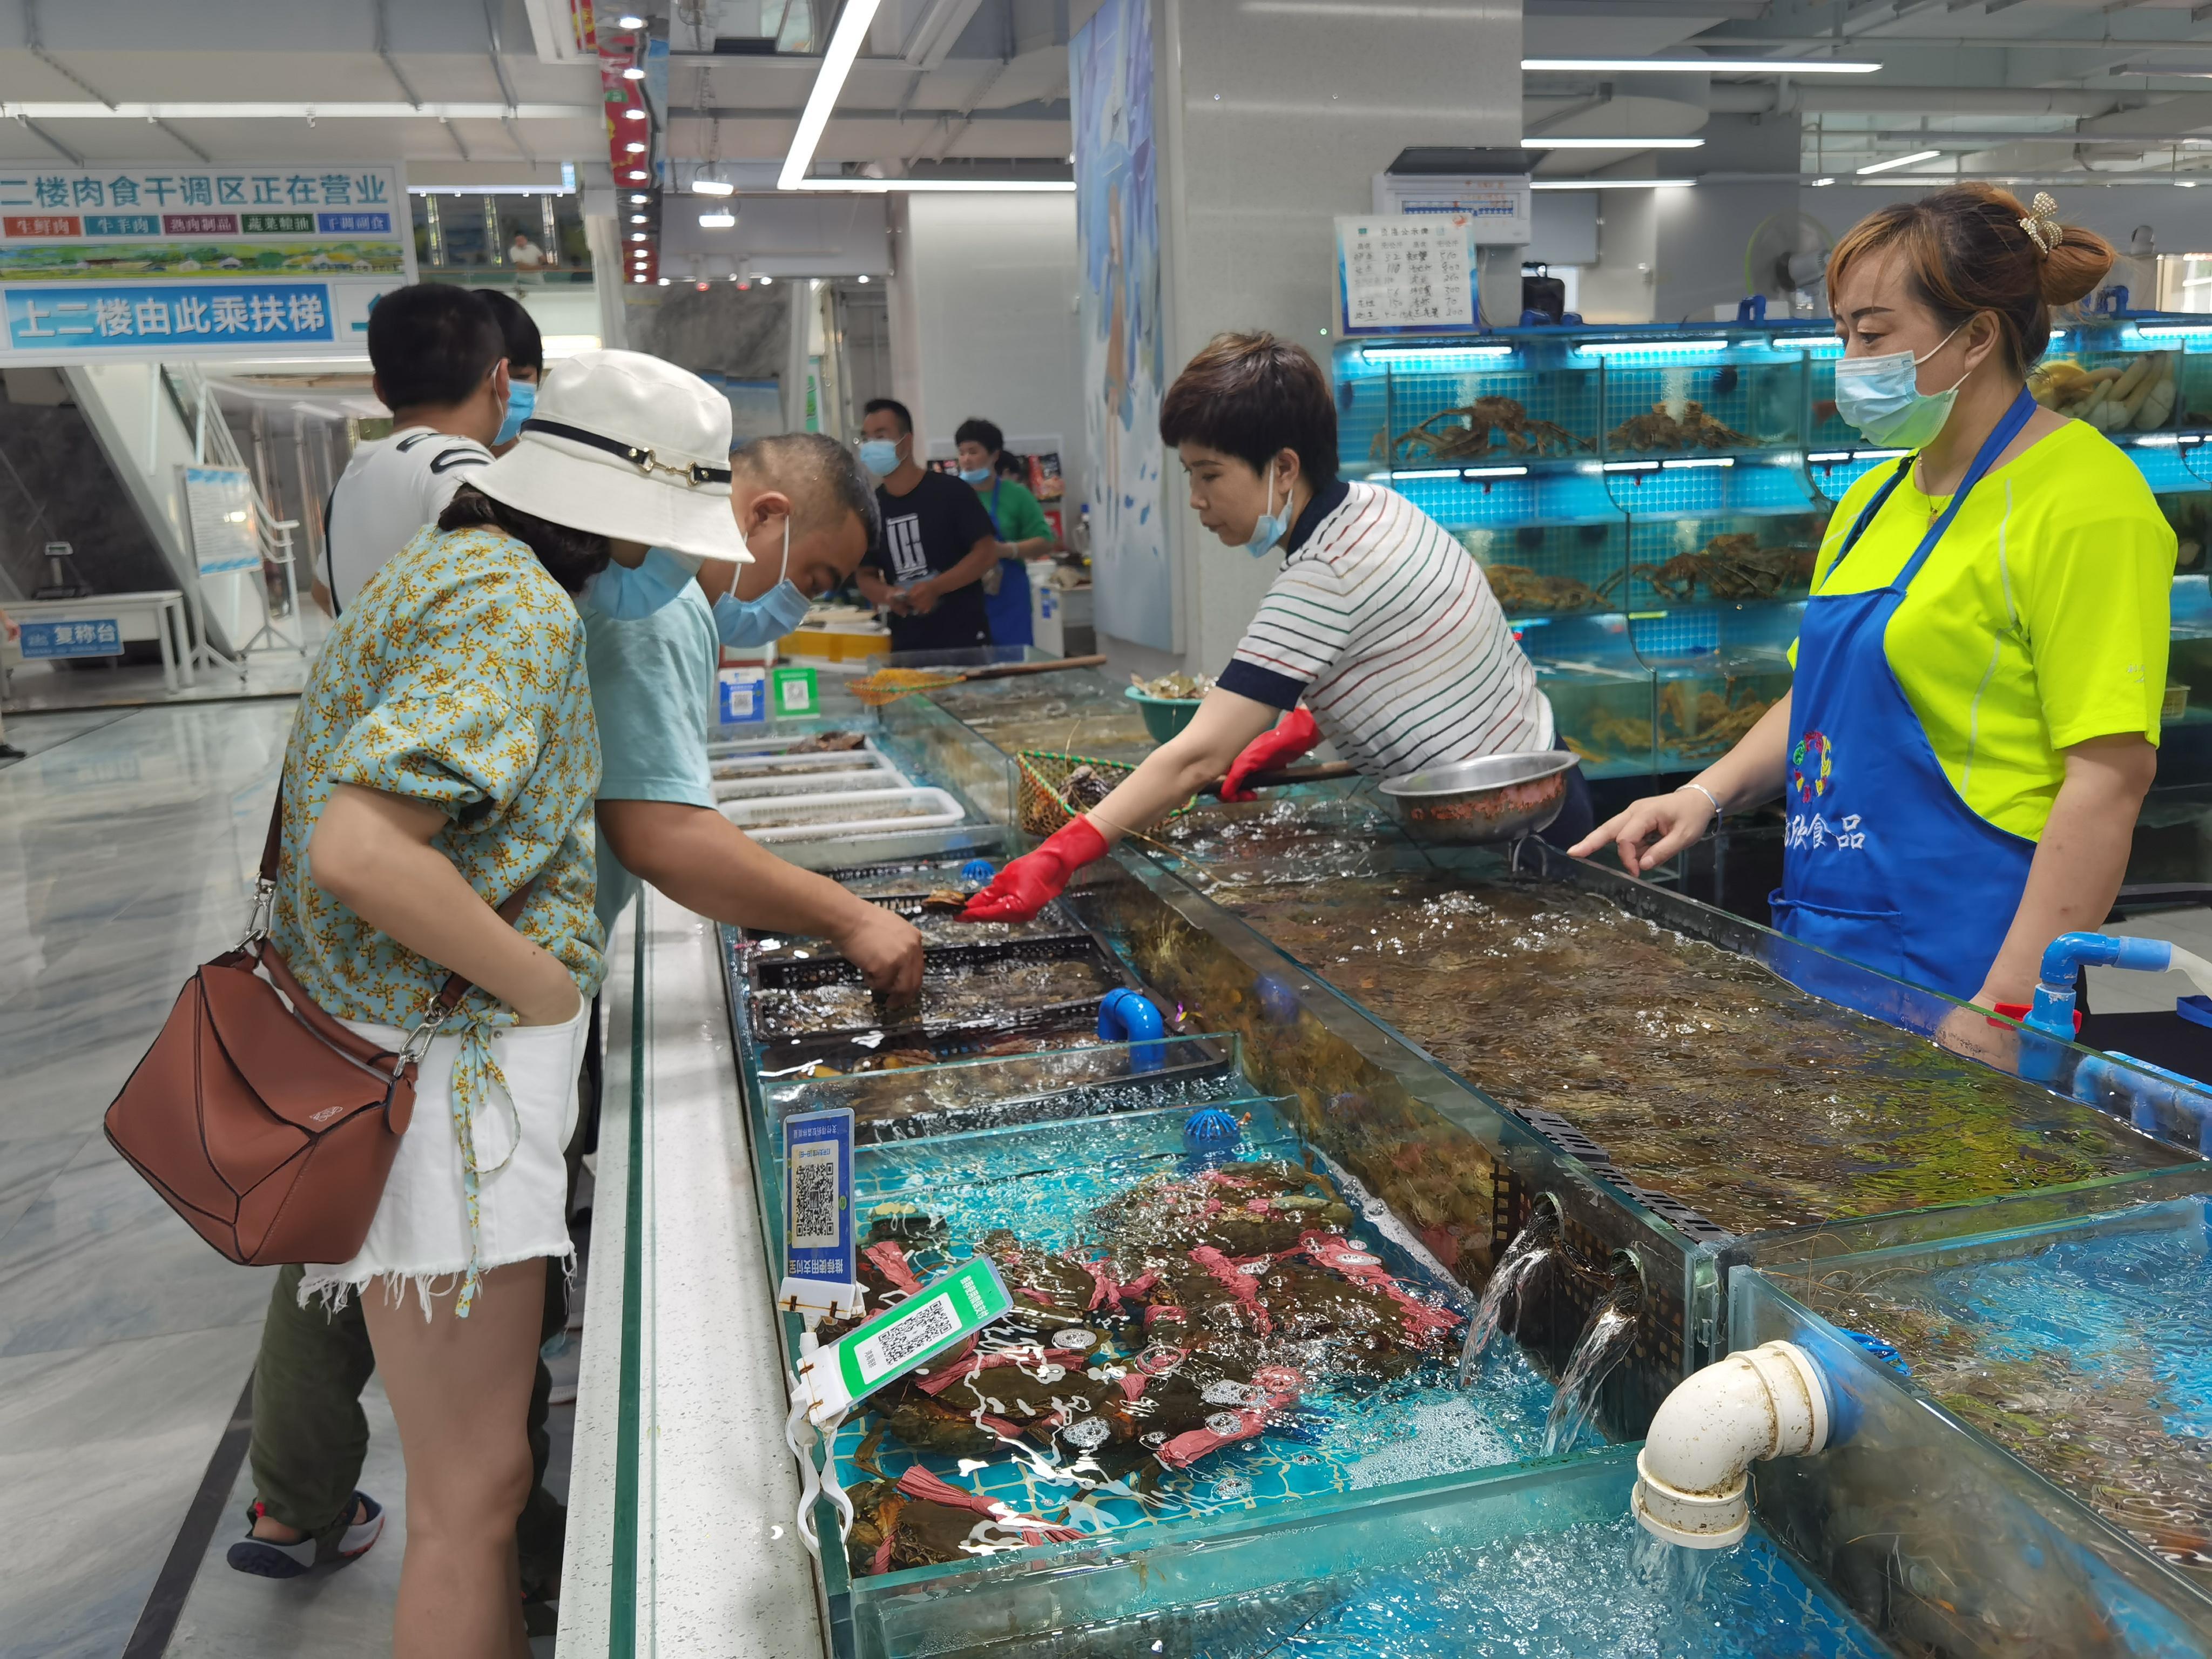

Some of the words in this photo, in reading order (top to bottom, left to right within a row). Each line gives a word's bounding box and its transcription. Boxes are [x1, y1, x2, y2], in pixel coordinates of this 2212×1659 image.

[0, 174, 388, 208] 二楼肉食干调区正在营业
[17, 219, 70, 235] 生鲜肉
[97, 218, 149, 234] 牛羊肉
[170, 217, 232, 233] 熟肉制品
[18, 294, 326, 338] 上二楼由此乘扶梯
[53, 623, 116, 645] 复称台
[788, 1257, 844, 1274] 推荐使用支付宝
[961, 1275, 988, 1319] 推荐使用微信支付
